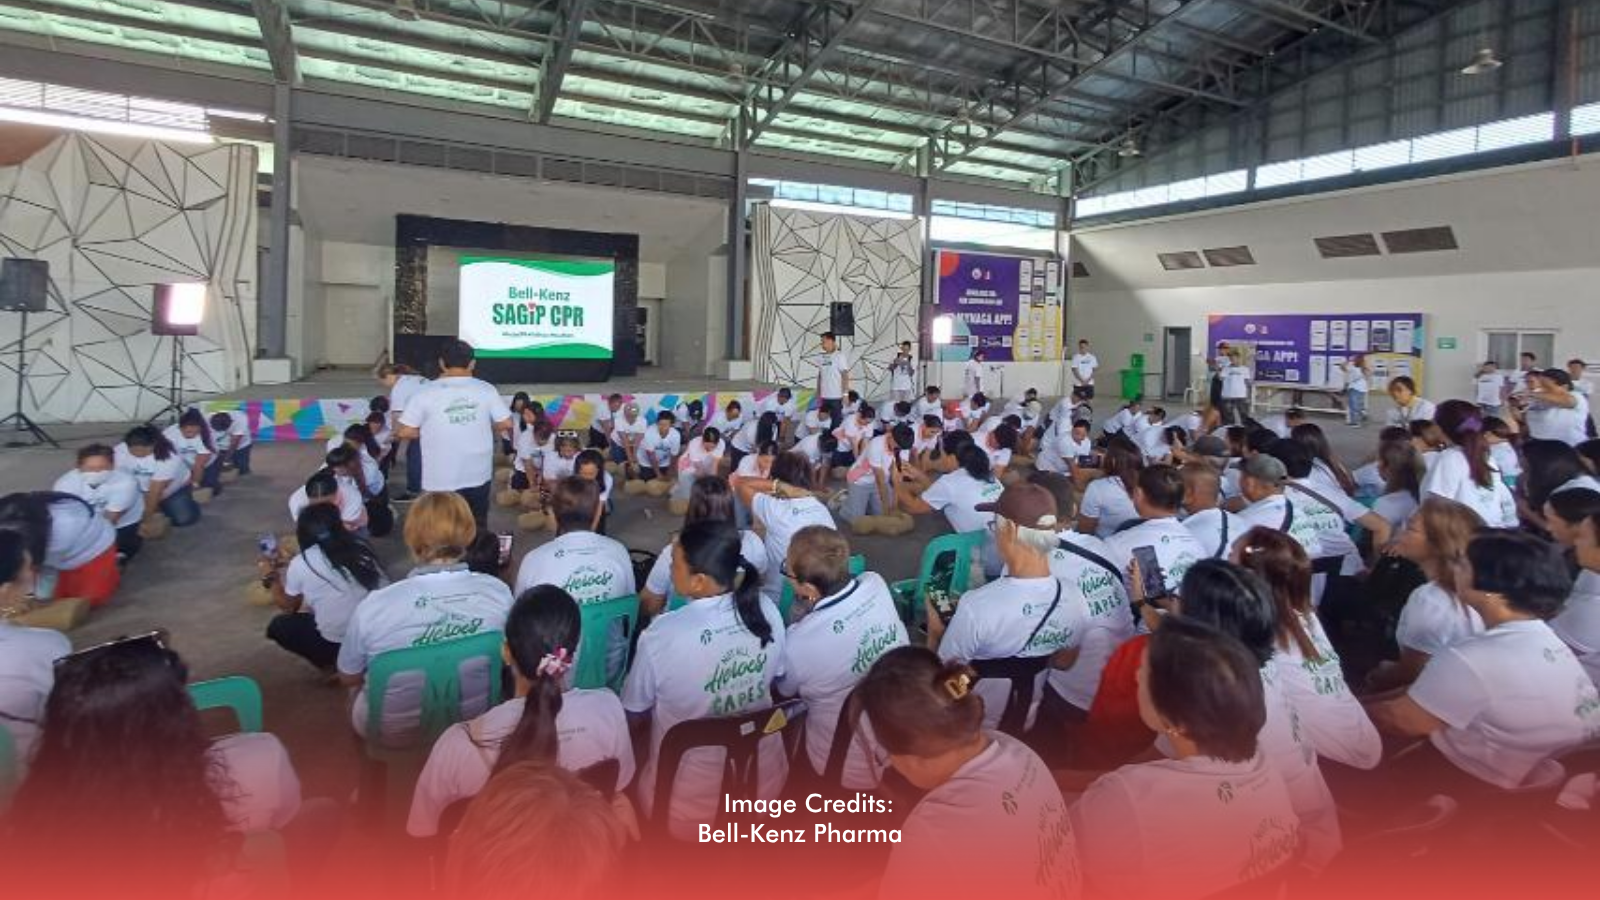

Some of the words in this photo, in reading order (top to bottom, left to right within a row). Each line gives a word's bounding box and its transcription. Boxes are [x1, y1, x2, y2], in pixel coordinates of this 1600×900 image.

[508, 286, 570, 301] Bell-Kenz
[550, 305, 584, 327] CPR
[704, 653, 767, 693] Heroes
[713, 680, 766, 715] CAPES
